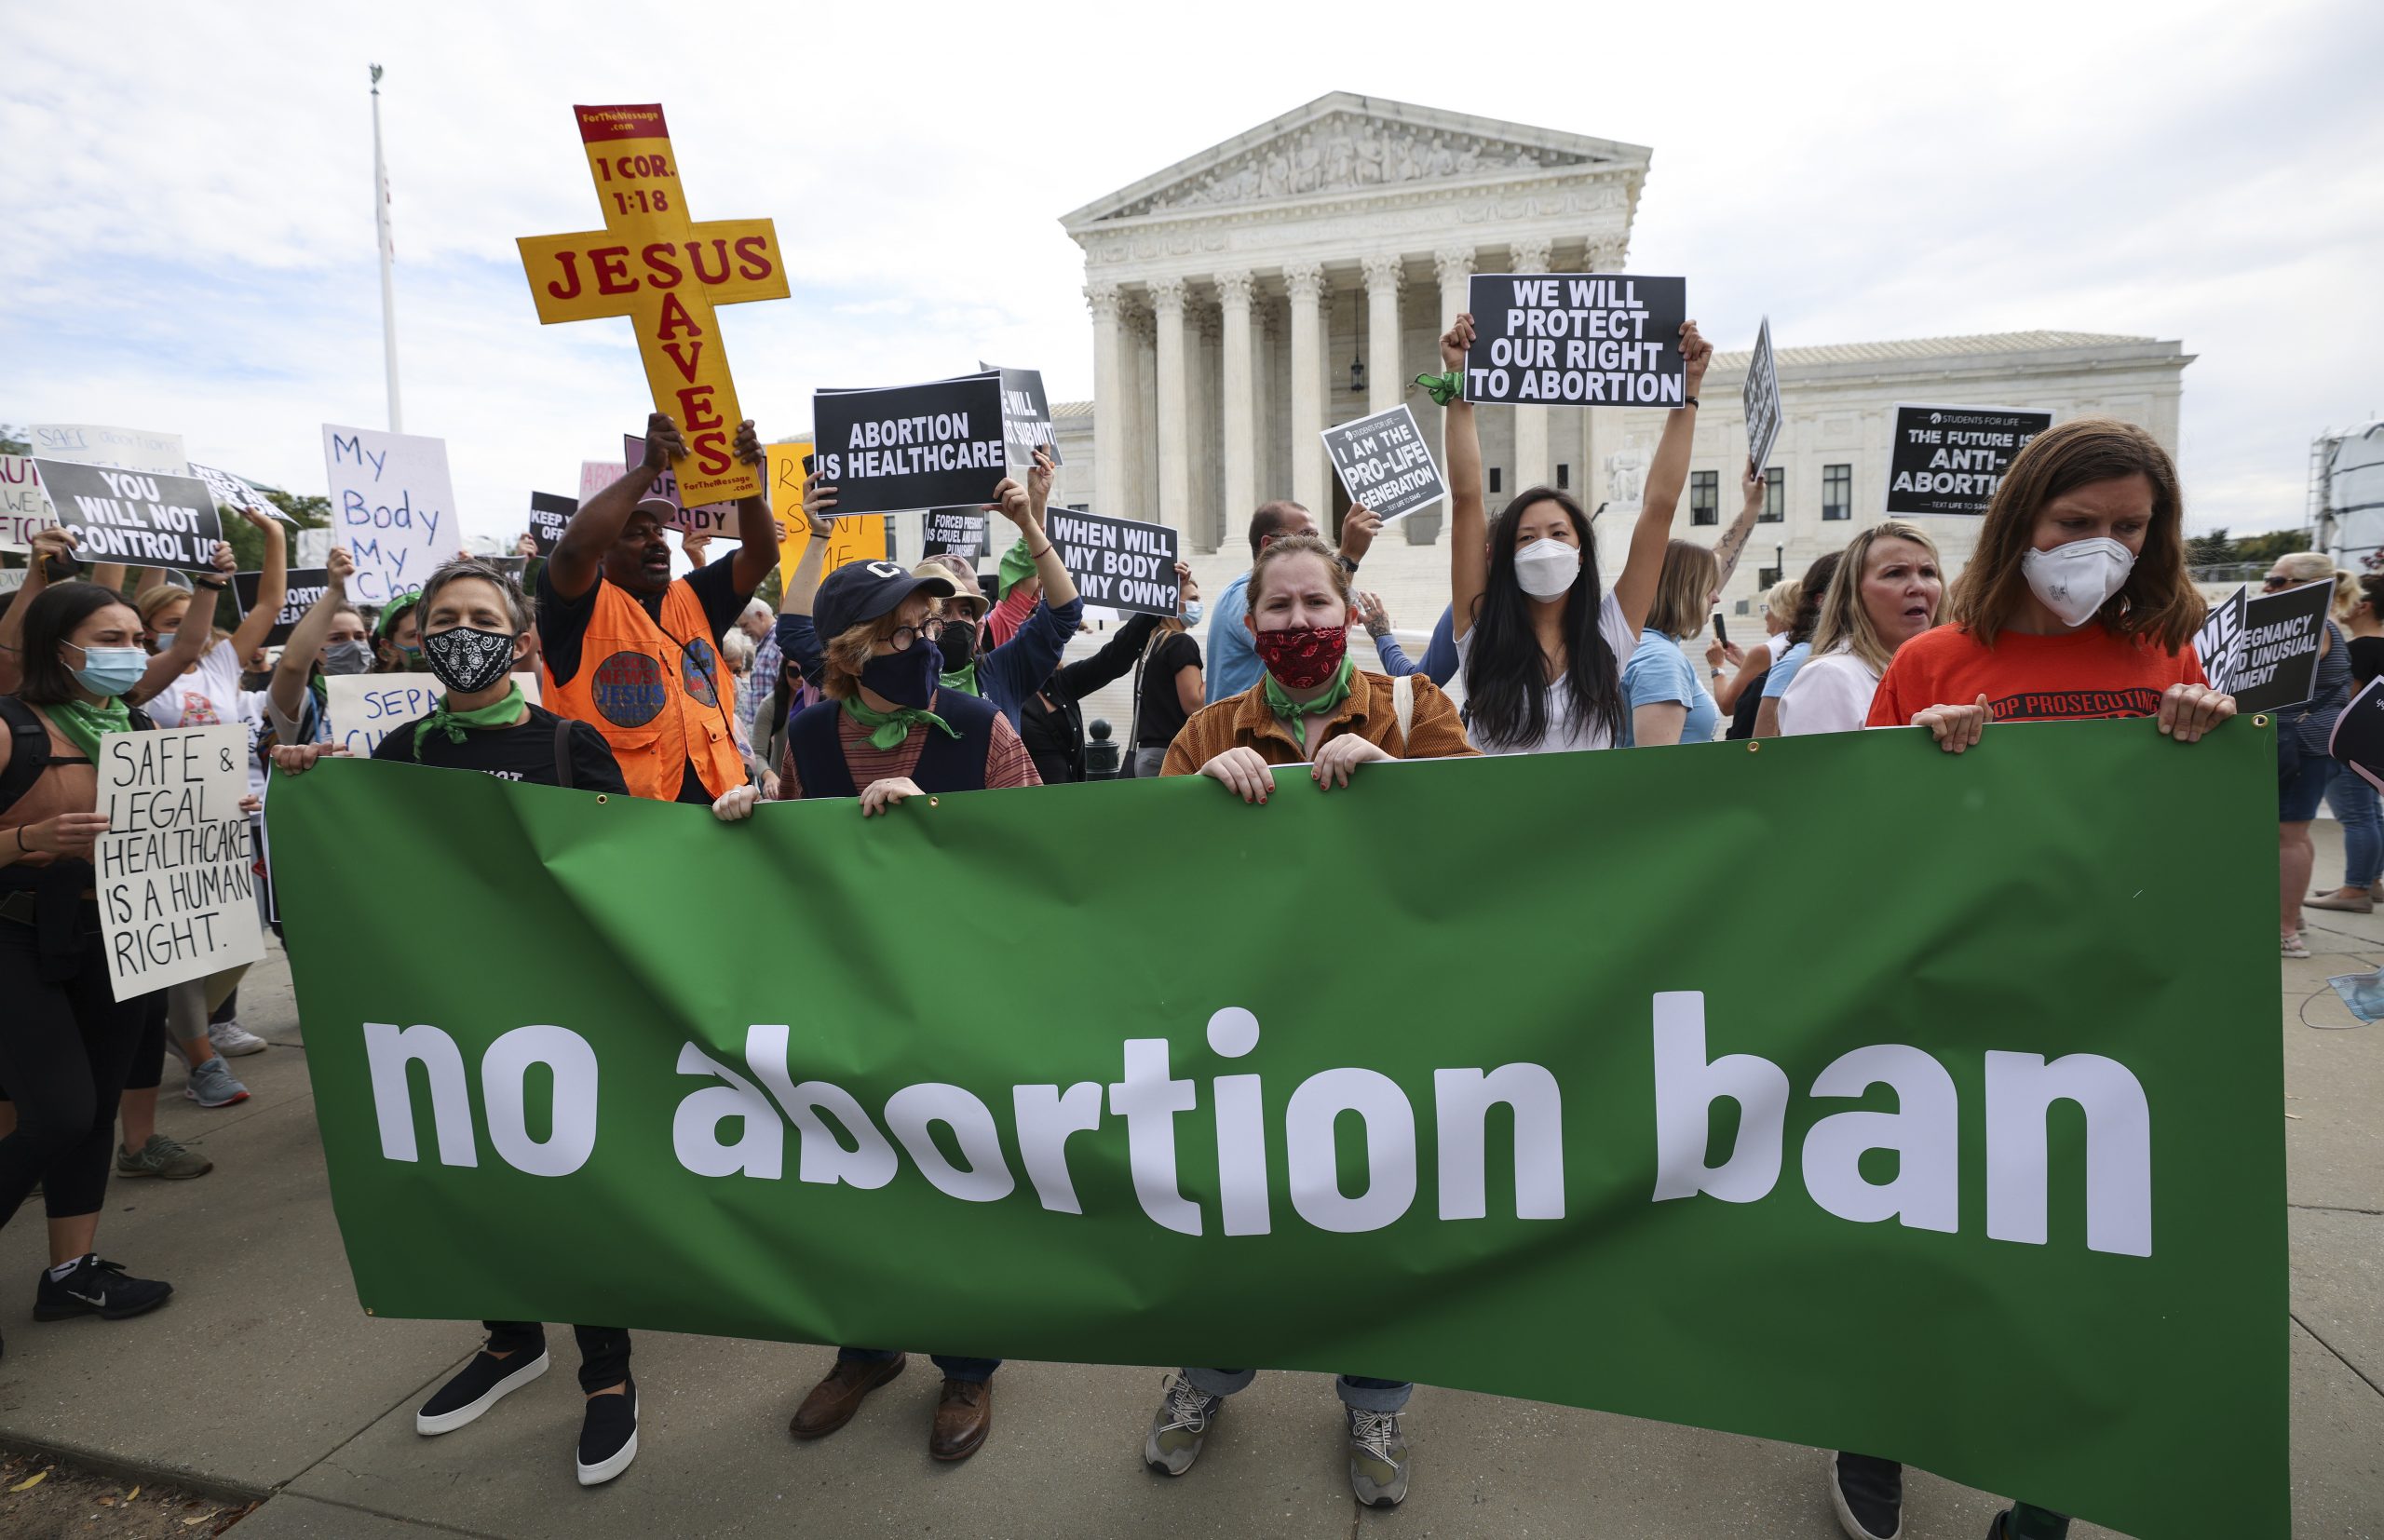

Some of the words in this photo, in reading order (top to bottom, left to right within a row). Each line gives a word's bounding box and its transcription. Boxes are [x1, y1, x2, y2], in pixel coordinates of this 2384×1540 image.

[583, 112, 658, 123] ForTheMessage
[611, 122, 634, 131] .com
[597, 157, 612, 182] 1
[616, 155, 676, 180] COR.
[613, 190, 669, 215] 1:18
[548, 236, 773, 300] JESUS
[1512, 280, 1559, 307] WE
[1569, 280, 1644, 308] WILL
[1507, 308, 1649, 339] PROTECT
[1491, 337, 1556, 369] OUR
[1566, 340, 1663, 371] RIGHT
[1470, 368, 1510, 399] TO
[1519, 370, 1682, 402] ABORTION
[1007, 390, 1037, 416] WILL
[848, 412, 969, 450] ABORTION
[1013, 421, 1054, 446] SUBMIT
[1943, 415, 1984, 426] STUDENTS
[1984, 416, 2002, 426] FOR
[2003, 417, 2019, 426] LIFE
[1338, 447, 1348, 464] I
[1352, 436, 1378, 459] AM
[1379, 424, 1412, 447] THE
[1908, 429, 1943, 444] THE
[1947, 430, 2013, 447] FUTURE
[333, 433, 386, 482] My
[819, 453, 842, 480] IS
[848, 439, 1005, 479] HEALTHCARE
[1343, 440, 1428, 491] PRO-LIFE
[1929, 448, 2007, 471] ANTI-
[98, 470, 160, 503] YOU
[684, 476, 751, 490] ForTheMessage
[734, 483, 753, 492] .com
[1359, 466, 1435, 510] GENERATION
[1892, 471, 2004, 495] ABORTI
[74, 495, 148, 528] WILL
[148, 503, 199, 534] NOT
[344, 489, 439, 547] Body
[531, 509, 562, 526] KEEP
[669, 508, 726, 530] ODY
[935, 514, 964, 530] FORCED
[65, 524, 191, 562] CONTROL
[927, 528, 936, 541] IS
[936, 529, 961, 543] CRUEL
[1053, 516, 1117, 548] WHEN
[1122, 527, 1172, 558] WILL
[352, 536, 407, 577] My
[866, 561, 901, 579] C
[1064, 545, 1098, 571] MY
[1104, 550, 1161, 580] BODY
[1080, 573, 1113, 600] MY
[1118, 578, 1178, 609] OWN?
[611, 655, 648, 669] GOOD
[2252, 633, 2317, 668] UNUSUAL
[599, 669, 660, 685] NEWS!
[598, 684, 665, 704] JESUS
[2025, 691, 2160, 714] PROSECUTING
[113, 735, 205, 787] SAFE
[220, 748, 234, 772] &
[109, 785, 218, 834] LEGAL
[103, 818, 251, 879] HEALTHCARE
[106, 884, 132, 925] IS
[145, 878, 163, 921] A
[170, 860, 252, 912] HUMAN
[114, 912, 228, 978] RIGHT.
[363, 1022, 598, 1177] no
[672, 1006, 1565, 1236] abortion
[1652, 991, 2152, 1258] ban
